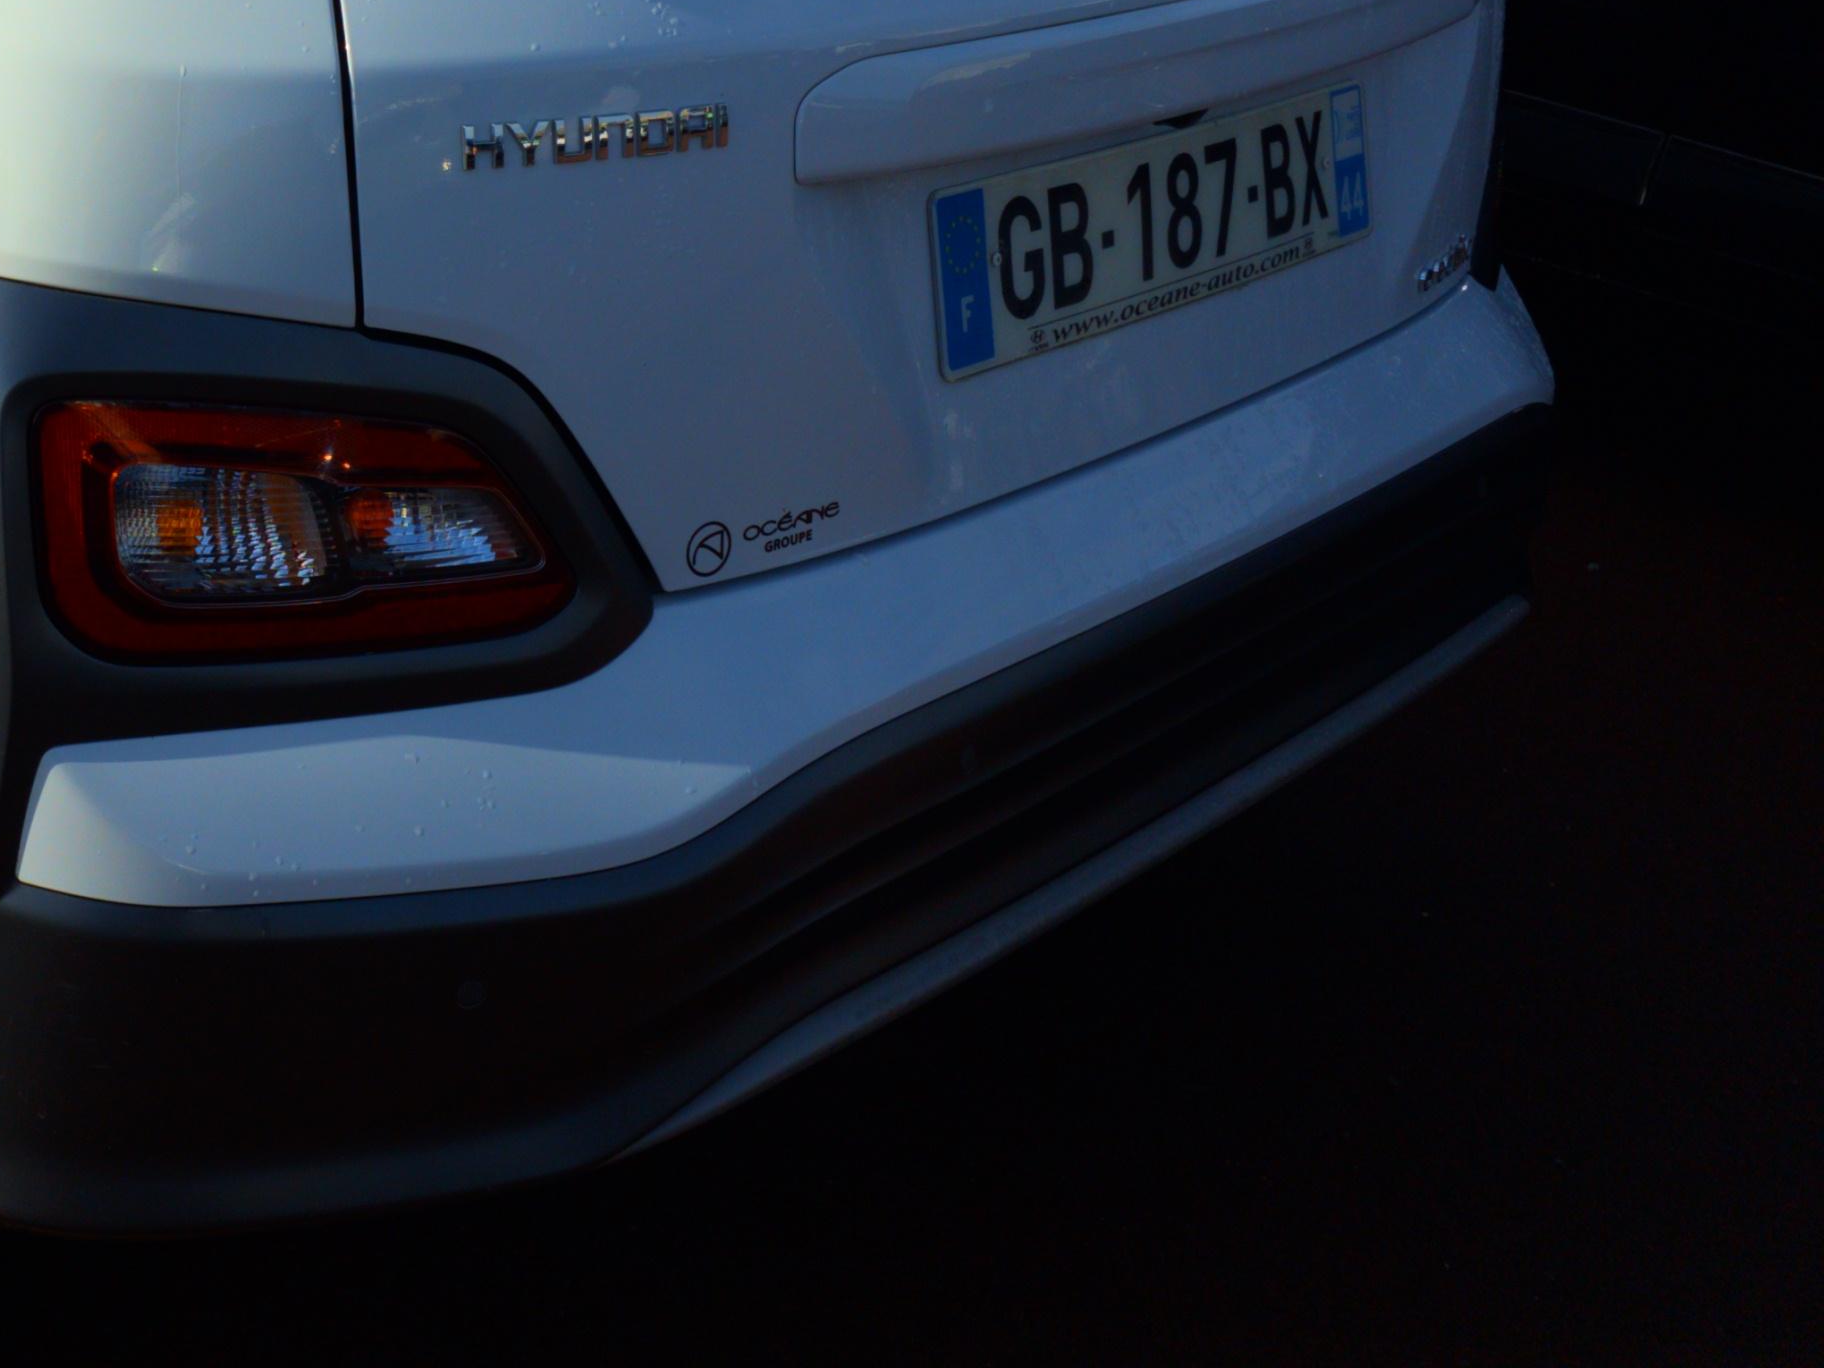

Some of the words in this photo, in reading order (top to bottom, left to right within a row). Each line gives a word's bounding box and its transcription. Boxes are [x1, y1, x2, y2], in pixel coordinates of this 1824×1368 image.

[462, 103, 729, 171] HYUNDAI
[997, 110, 1329, 320] GB-187-BX
[1340, 171, 1364, 221] 44
[961, 294, 976, 333] F
[1051, 245, 1302, 345] www.oceane-auto.com
[764, 529, 813, 553] GROUPE
